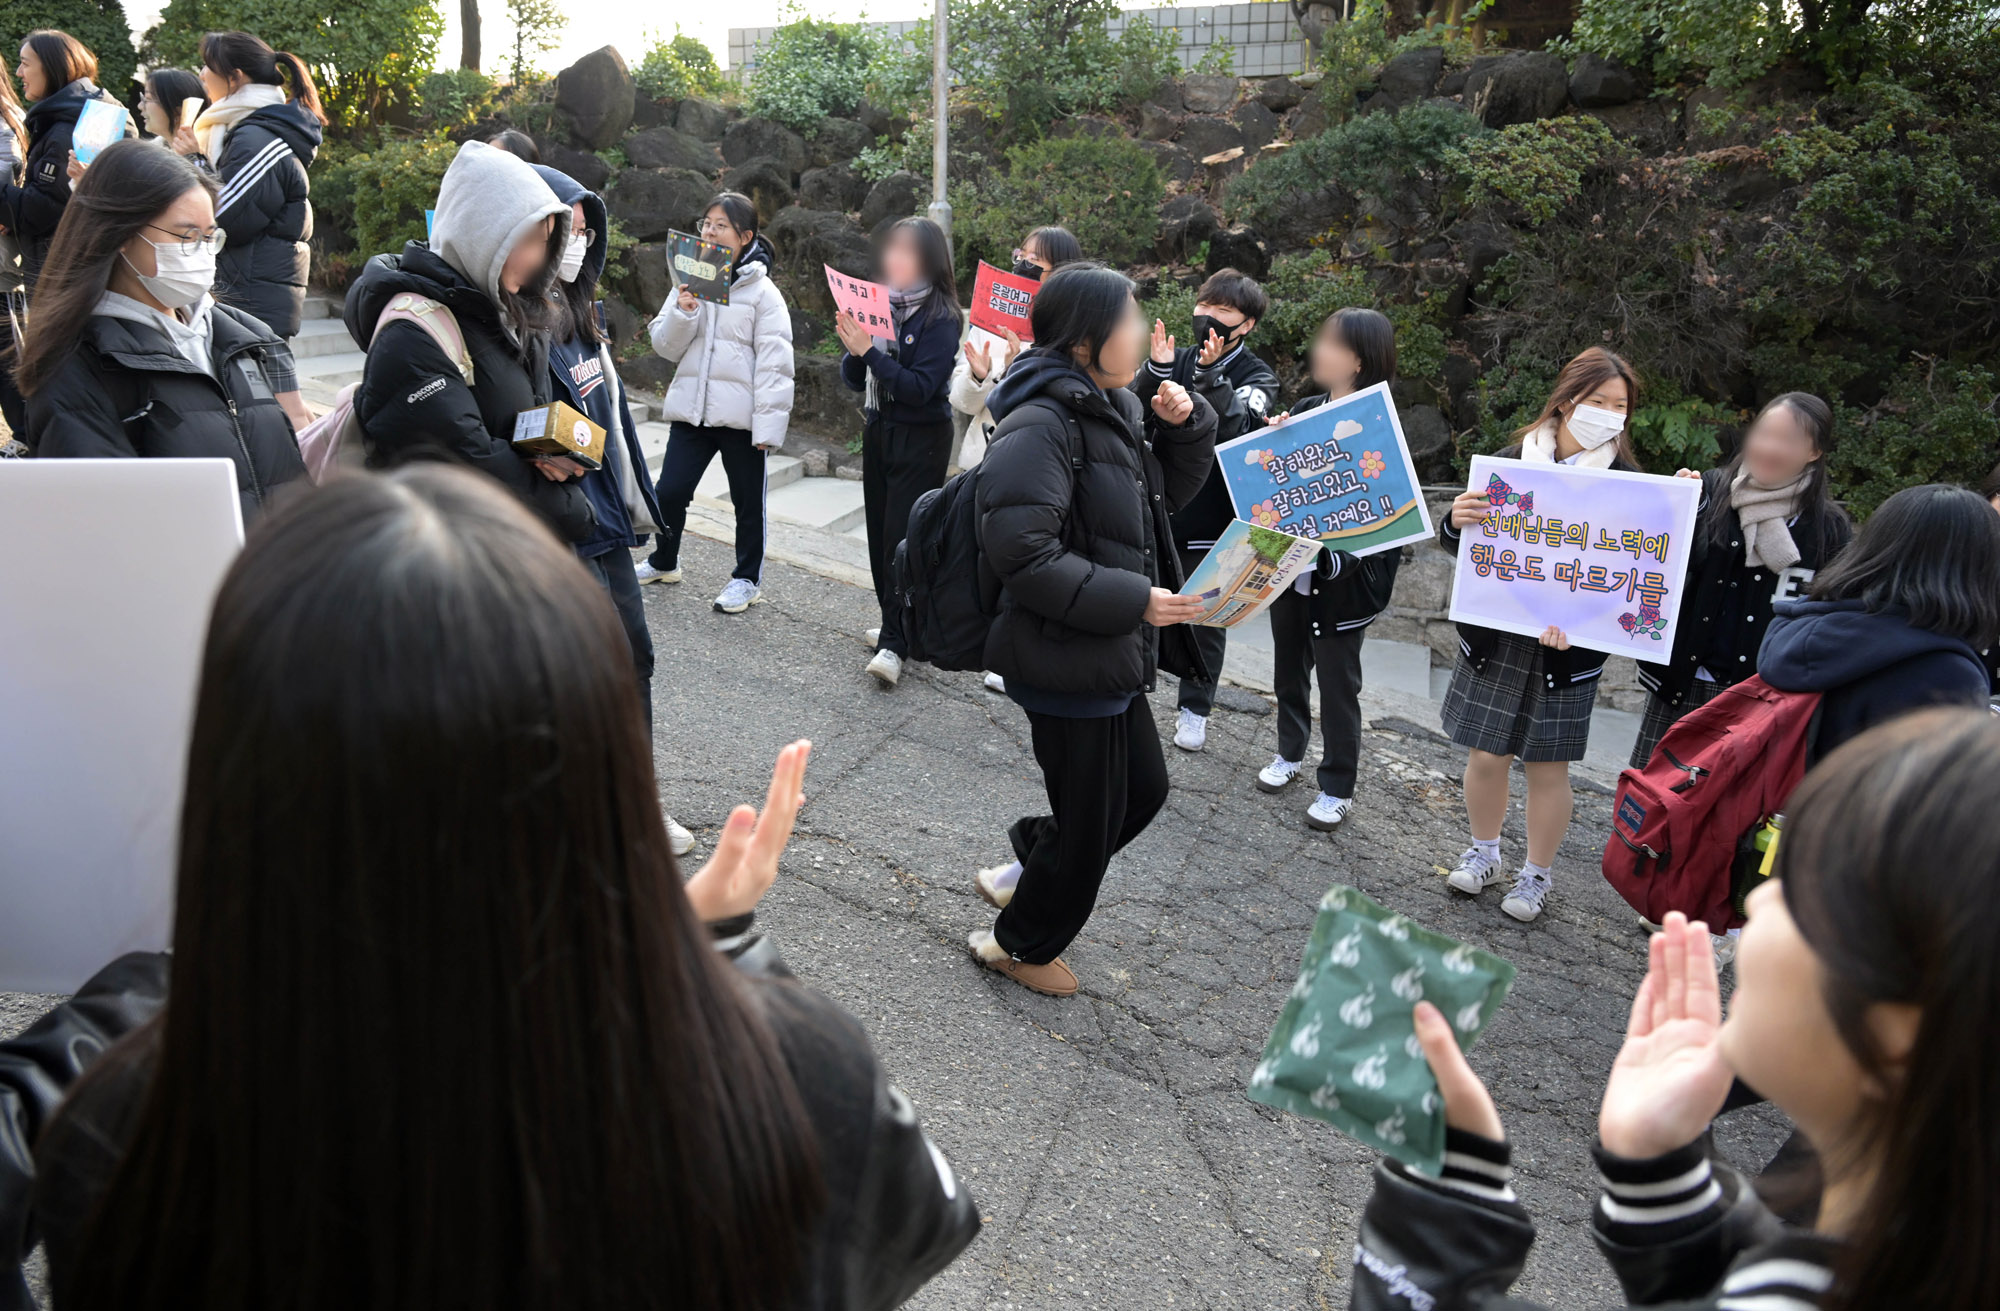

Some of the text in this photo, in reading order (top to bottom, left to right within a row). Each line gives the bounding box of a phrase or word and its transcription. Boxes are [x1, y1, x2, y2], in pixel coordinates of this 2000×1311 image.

[990, 297, 1029, 318] 수능대박
[992, 282, 1031, 304] 은광여고
[1268, 439, 1351, 484] 잘해왔고,
[1272, 469, 1369, 518] 잘하고있고,
[1273, 515, 1322, 540] 하실
[1323, 499, 1378, 532] 거예요
[1479, 510, 1670, 563] 선배님들의 노력에
[1470, 543, 1668, 607] 행운도 따르기를
[1770, 567, 1815, 604] E
